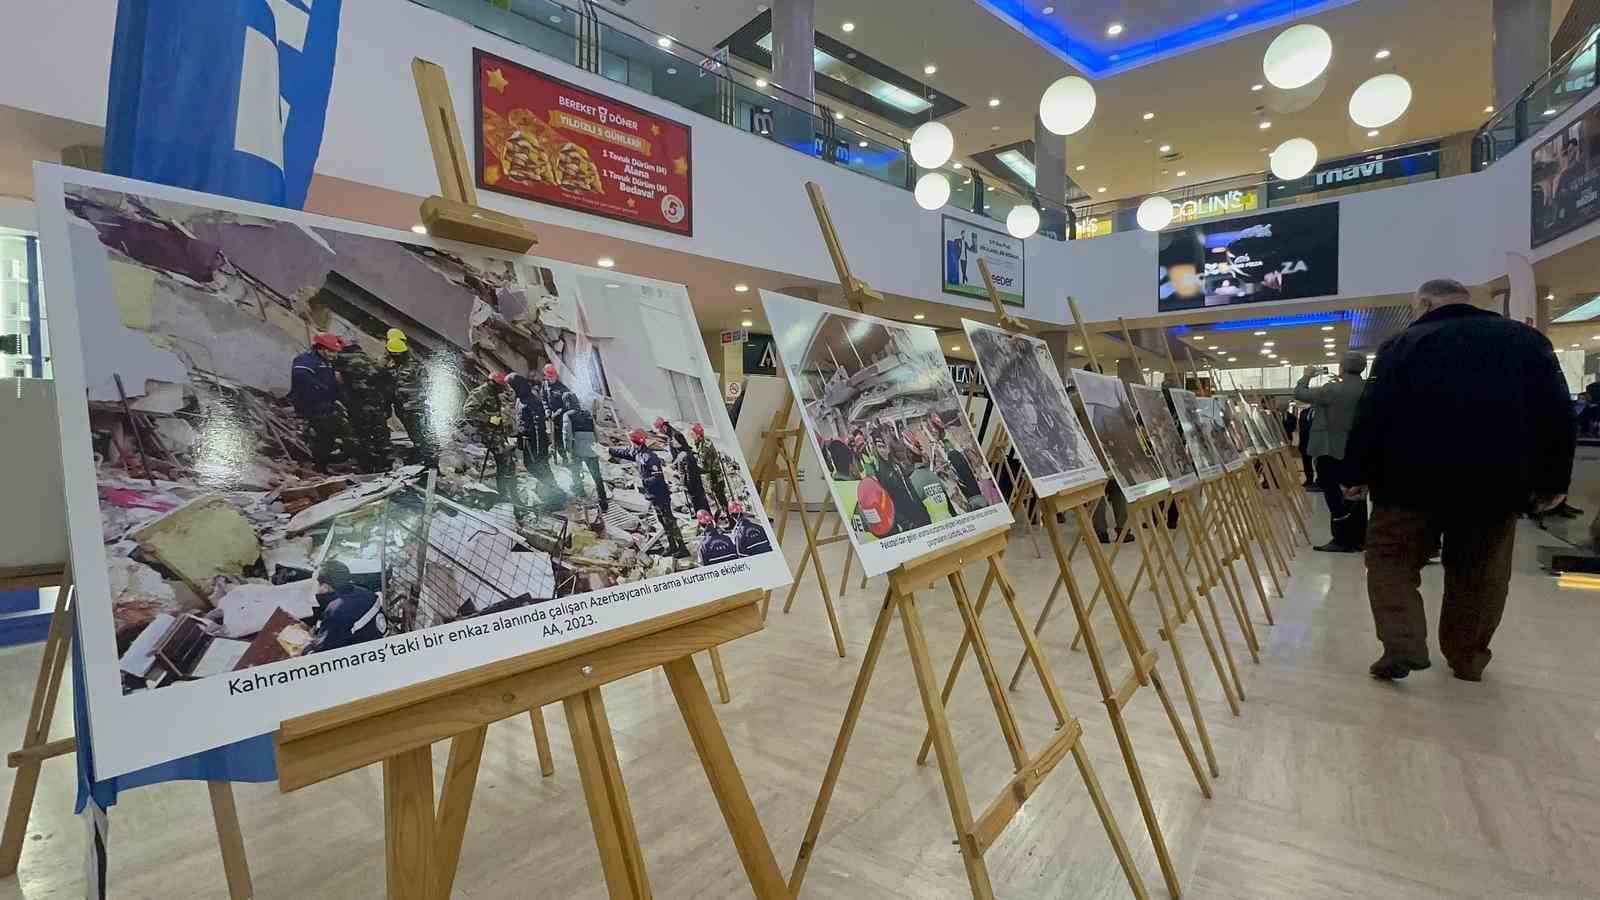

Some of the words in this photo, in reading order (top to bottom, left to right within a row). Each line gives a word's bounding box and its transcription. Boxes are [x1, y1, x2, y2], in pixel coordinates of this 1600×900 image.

[559, 95, 597, 116] BEREKET
[609, 112, 638, 129] DÖNER
[602, 149, 608, 157] 1
[608, 151, 631, 165] Tavuk
[631, 158, 656, 172] Dürüm
[624, 165, 650, 179] Alana
[1316, 154, 1384, 185] mavi
[602, 169, 608, 177] 1
[608, 170, 631, 183] Tavuk
[631, 176, 656, 190] Dürüm
[620, 181, 655, 199] Bedava!
[667, 201, 678, 216] 5
[228, 637, 420, 696] Kahramanmaraş'taki
[424, 632, 446, 649] bir
[449, 623, 490, 642] enkaz
[492, 609, 547, 633] alanında
[548, 601, 589, 621] çalışan
[589, 586, 652, 609] Azerbaycanlı
[653, 579, 683, 594] arama
[682, 570, 720, 586] kurtarma
[720, 561, 752, 578] ekipleri,
[542, 624, 565, 639] AA,
[566, 613, 599, 632] 2023.
